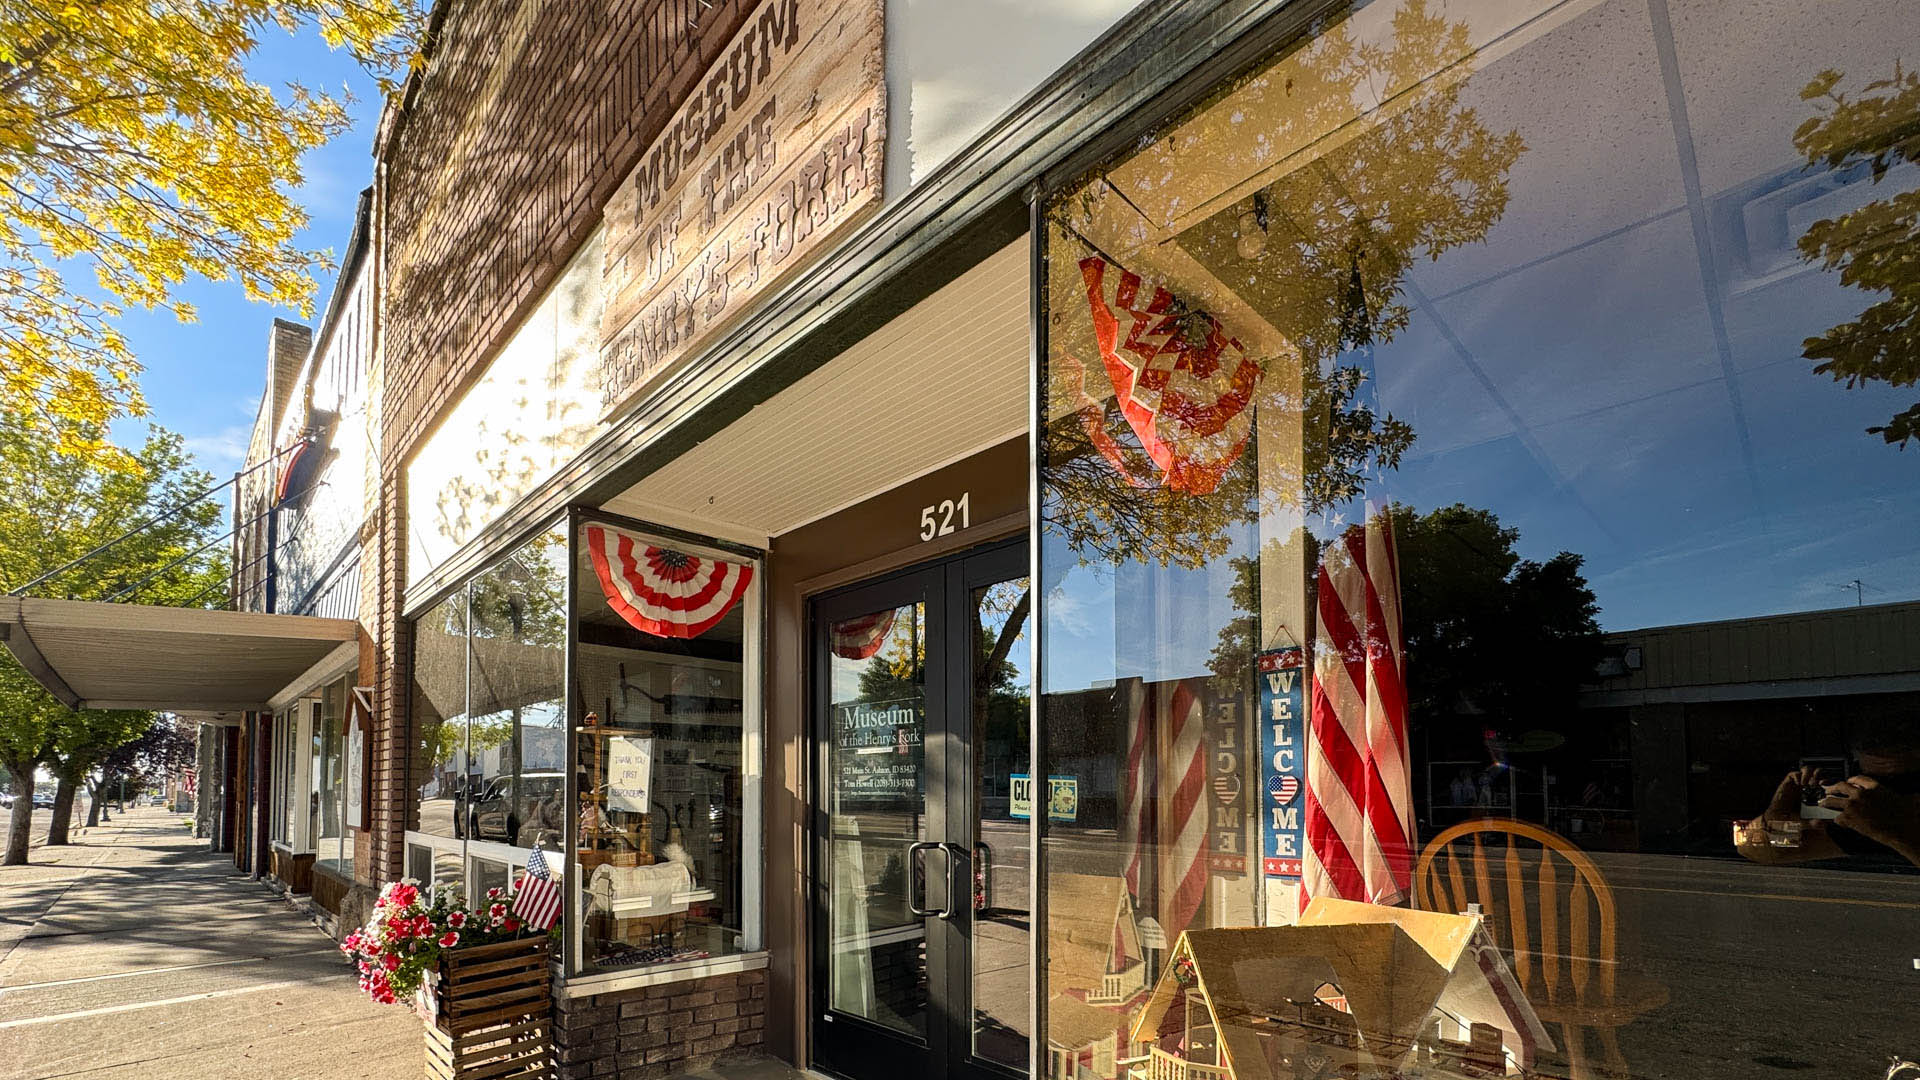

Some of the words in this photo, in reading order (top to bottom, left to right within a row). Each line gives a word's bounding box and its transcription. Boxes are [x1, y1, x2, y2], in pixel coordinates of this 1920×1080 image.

[635, 0, 799, 229] MUSEUM
[647, 202, 683, 291] OF
[700, 94, 777, 236] THE
[745, 107, 871, 289] FORK
[920, 492, 969, 542] 521
[839, 732, 848, 747] of
[849, 731, 862, 746] the
[864, 730, 897, 747] Henry's
[898, 728, 921, 743] Fork
[844, 706, 915, 730] Museum
[1014, 780, 1053, 802] CLOD
